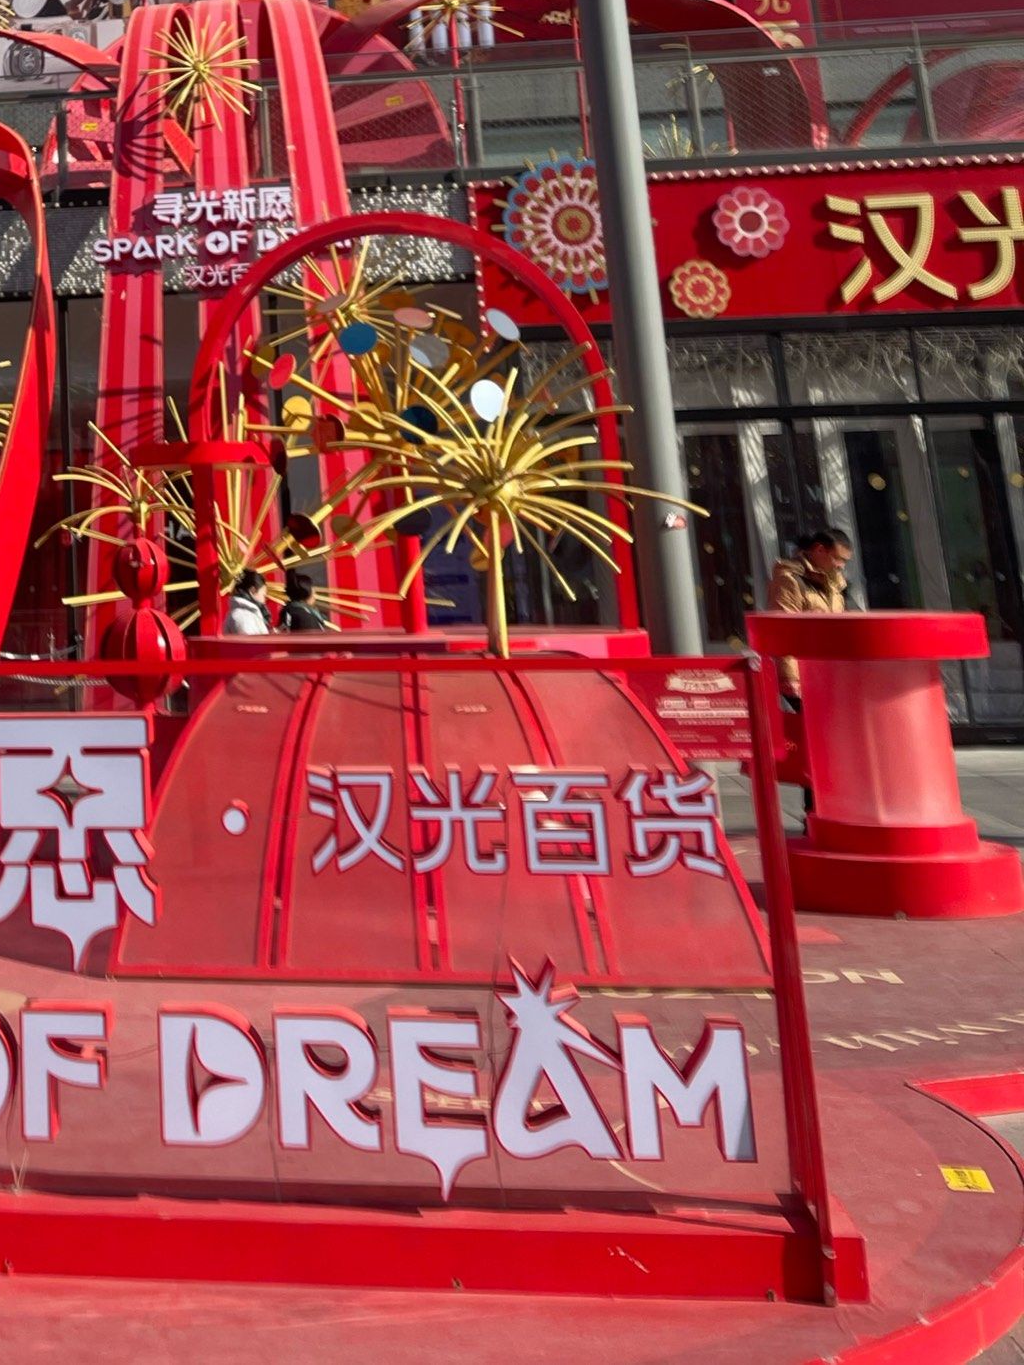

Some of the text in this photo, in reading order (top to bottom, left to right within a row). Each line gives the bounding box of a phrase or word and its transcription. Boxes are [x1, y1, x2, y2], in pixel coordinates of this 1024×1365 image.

[151, 186, 294, 227] 寻光新愿
[93, 234, 198, 263] SPARK
[205, 229, 249, 255] OF
[306, 765, 726, 878] 汉光百货
[157, 954, 758, 1203] DREAM
